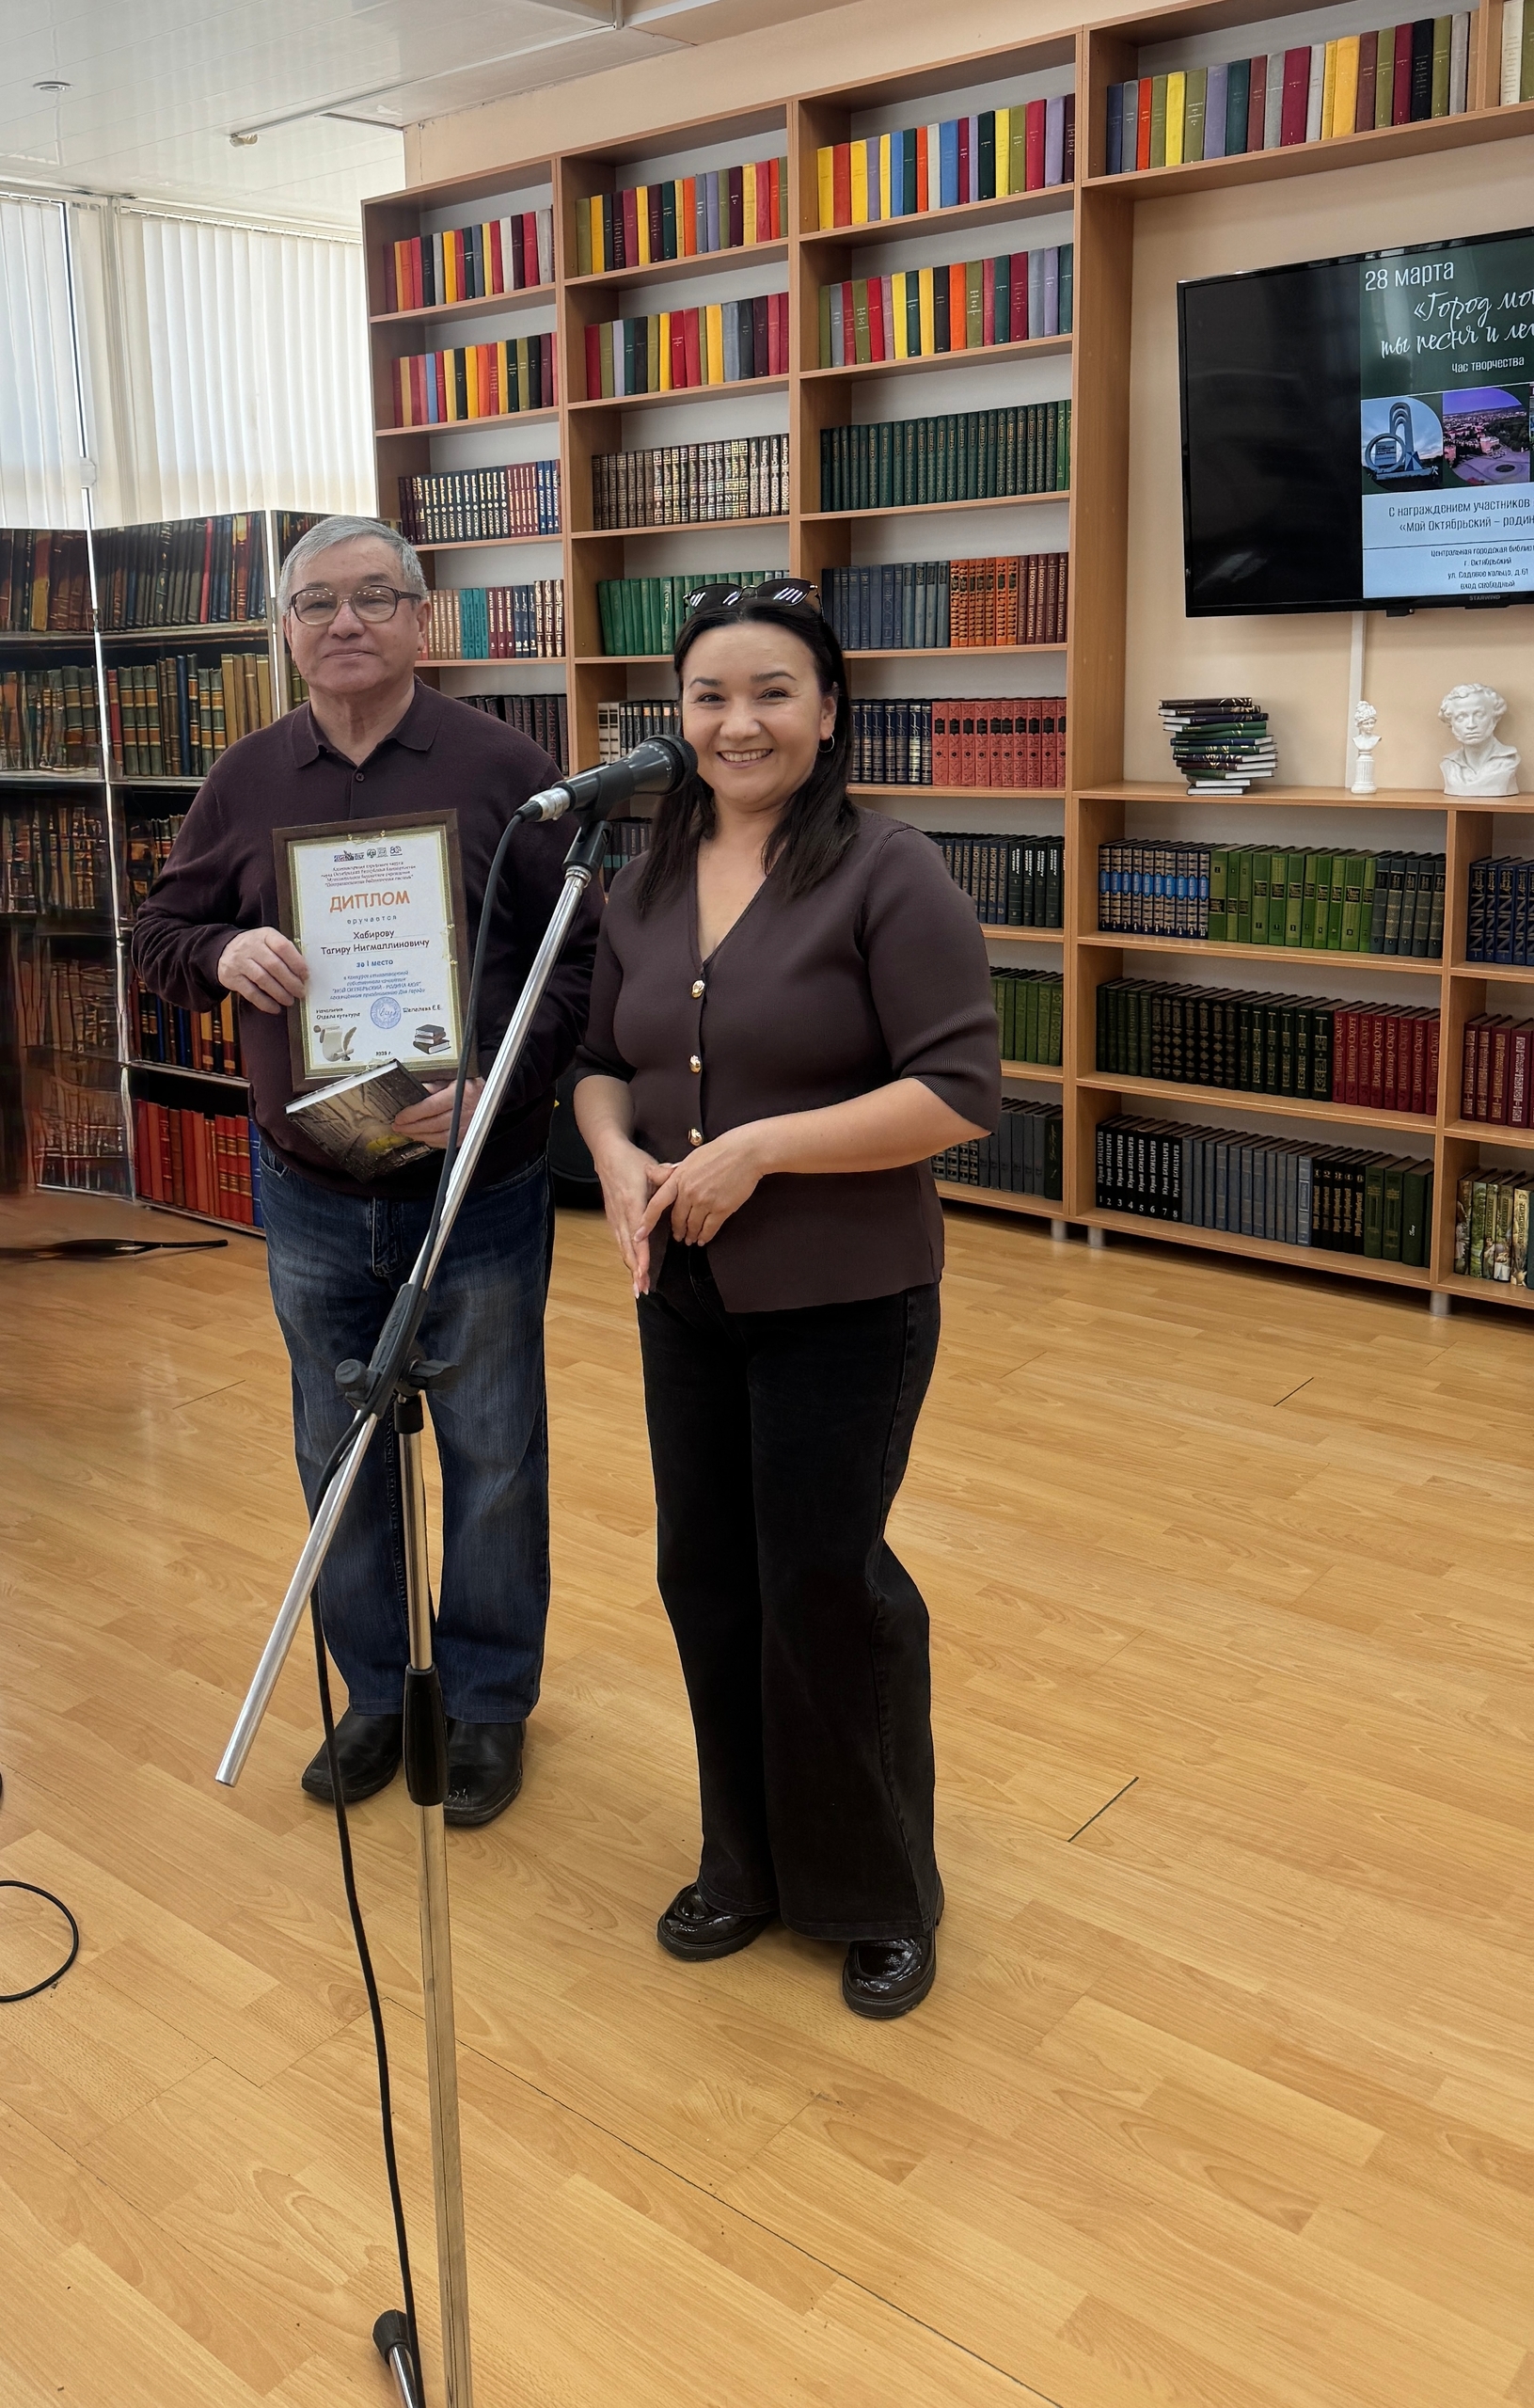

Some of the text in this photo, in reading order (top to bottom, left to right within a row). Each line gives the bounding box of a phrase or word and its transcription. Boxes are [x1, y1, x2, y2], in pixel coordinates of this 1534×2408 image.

[1365, 261, 1454, 292] 28 марта
[1496, 289, 1534, 310] мо
[1381, 323, 1534, 359] ты песня и ле
[1471, 356, 1525, 372] творчества
[1388, 499, 1530, 517] С награждением участников
[1400, 521, 1426, 532] «Мой
[1428, 517, 1492, 531] Октябрьский
[1503, 515, 1534, 527] родин
[1431, 545, 1534, 557] Центральная городская библио
[1471, 557, 1511, 566] Октябрьский
[1458, 570, 1486, 578] Садовое
[1478, 580, 1515, 590] свободный
[329, 890, 410, 913] ДИПЛОМ
[347, 914, 397, 925] вручается
[353, 930, 395, 940] Хабирову
[321, 946, 351, 955] Тагиру
[1106, 1197, 1112, 1206] 2
[1117, 1198, 1123, 1207] 3
[1149, 1205, 1155, 1213] 6
[1162, 1208, 1167, 1216] 7
[1172, 1210, 1178, 1218] 8
